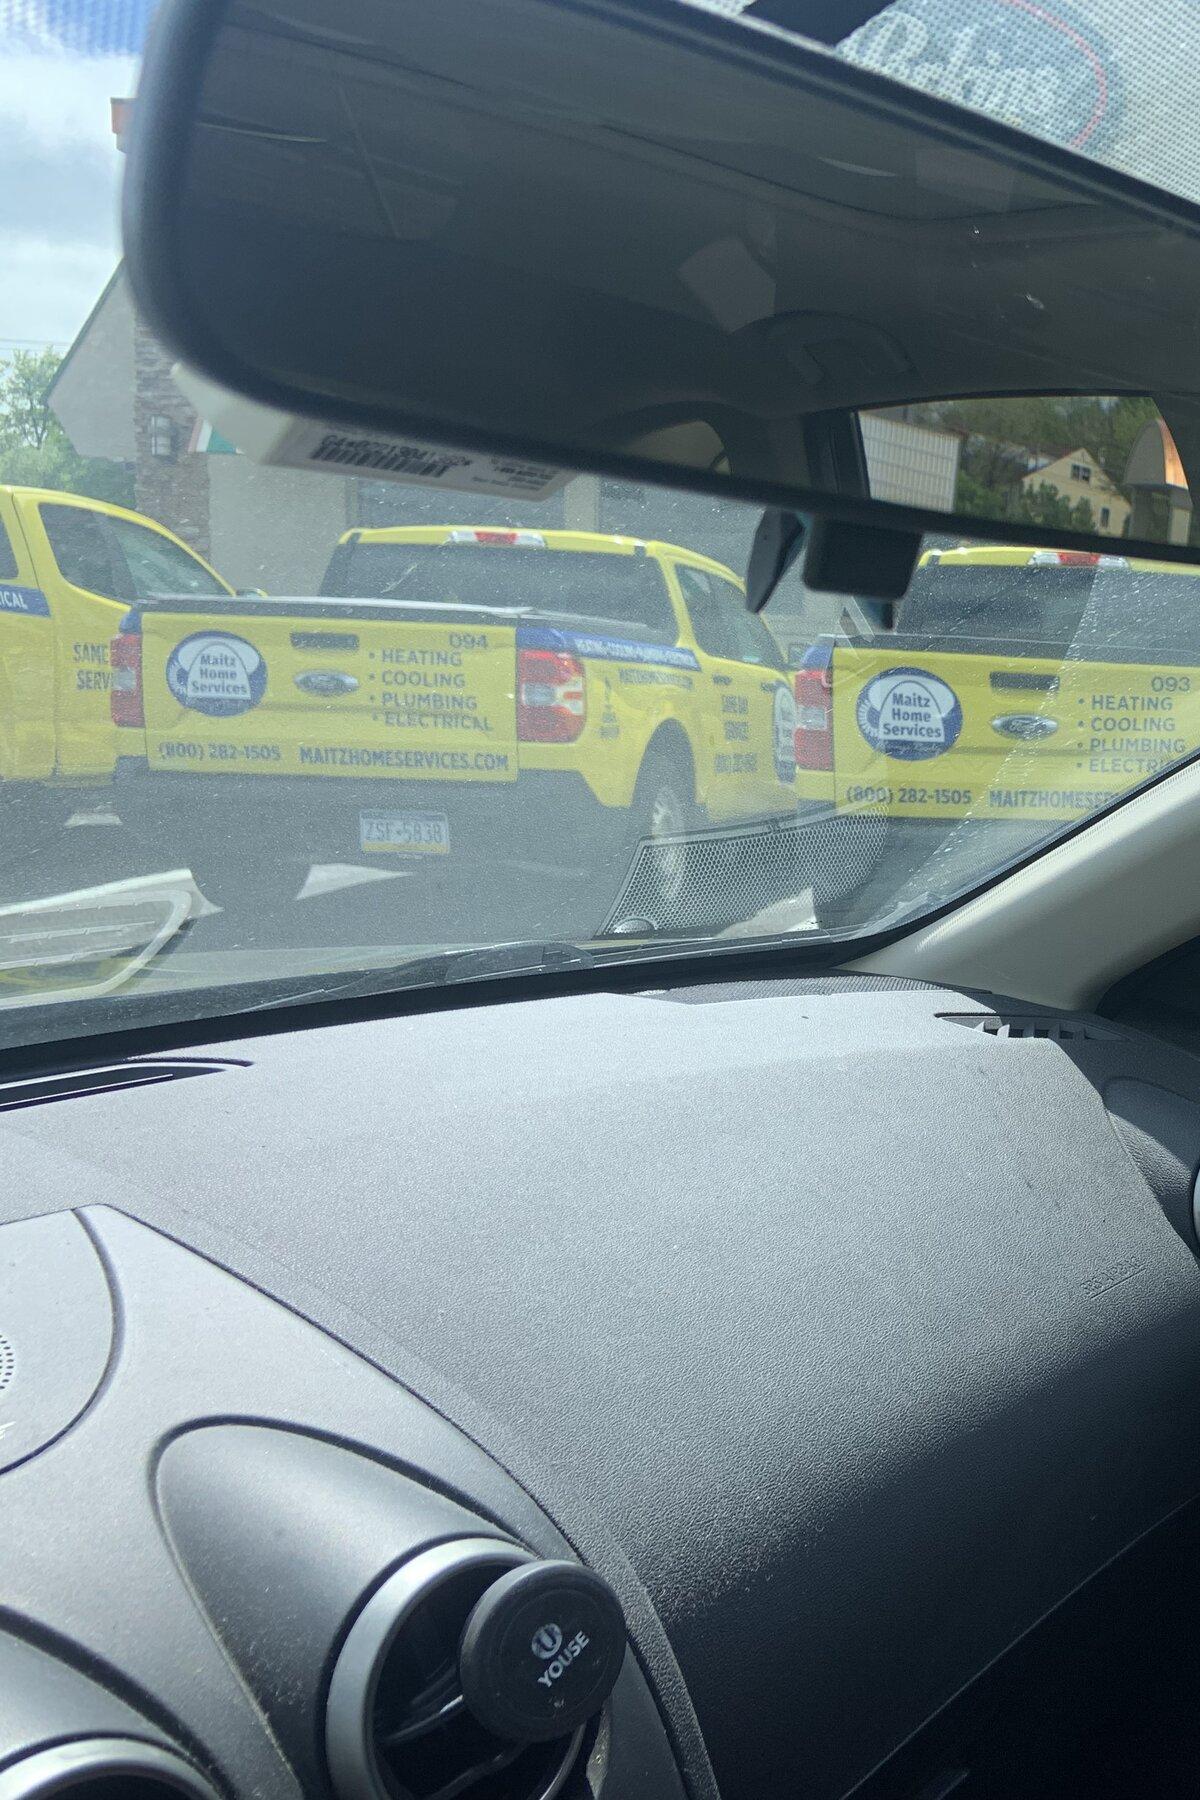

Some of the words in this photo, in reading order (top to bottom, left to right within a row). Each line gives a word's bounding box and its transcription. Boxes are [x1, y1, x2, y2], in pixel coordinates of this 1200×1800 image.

[449, 633, 488, 648] 094
[200, 653, 236, 667] Maitz
[381, 649, 463, 666] HEATING
[76, 669, 113, 691] SERV
[200, 668, 237, 680] Home
[381, 670, 466, 688] COOLING
[192, 681, 247, 695] Services
[1151, 676, 1191, 693] 093
[382, 692, 477, 711] PLUMBING
[892, 693, 931, 708] Maitz
[1091, 695, 1173, 712] HEATING
[384, 712, 493, 732] ELECTRICAL
[891, 709, 931, 723] Home
[1090, 717, 1176, 732] COOLING
[882, 724, 942, 738] Services
[159, 742, 204, 761] (800)
[208, 743, 281, 761] 282-1505
[1090, 738, 1186, 753] PLUMBING
[300, 746, 509, 771] MAITZHOMESERVICES.COM
[1089, 758, 1159, 774] ELECTR
[846, 785, 893, 805] (800)
[899, 788, 972, 805] 282-1505
[537, 1630, 590, 1687] YOUSE
